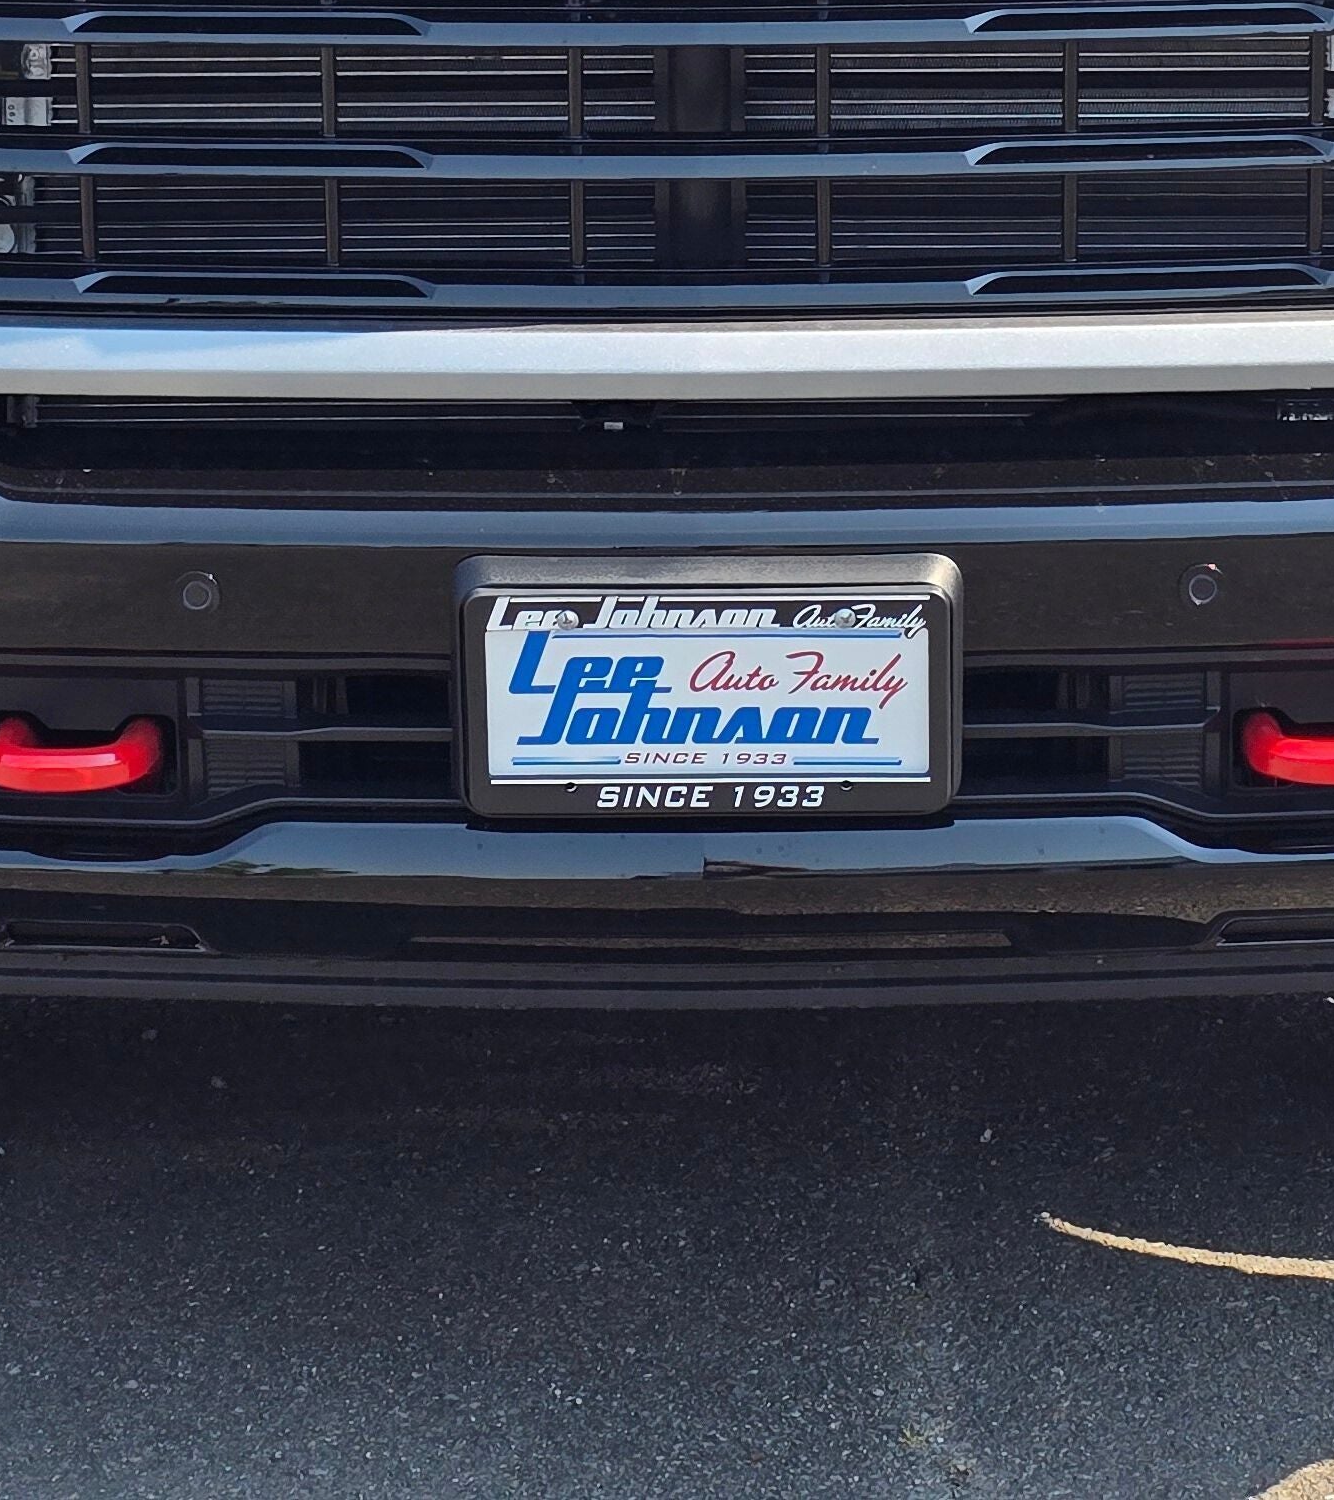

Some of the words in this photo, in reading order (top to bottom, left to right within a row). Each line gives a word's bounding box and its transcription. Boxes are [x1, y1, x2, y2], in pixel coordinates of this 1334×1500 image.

[582, 596, 781, 630] Johnson
[792, 604, 843, 629] Aut
[851, 603, 927, 639] Family
[509, 630, 673, 695] Lee
[689, 650, 780, 693] Auto
[785, 650, 909, 710] Family
[516, 680, 880, 746] Johnson
[624, 752, 708, 766] SINCE
[721, 752, 788, 766] 1933
[596, 785, 714, 809] SINCE
[733, 785, 825, 808] 1933
